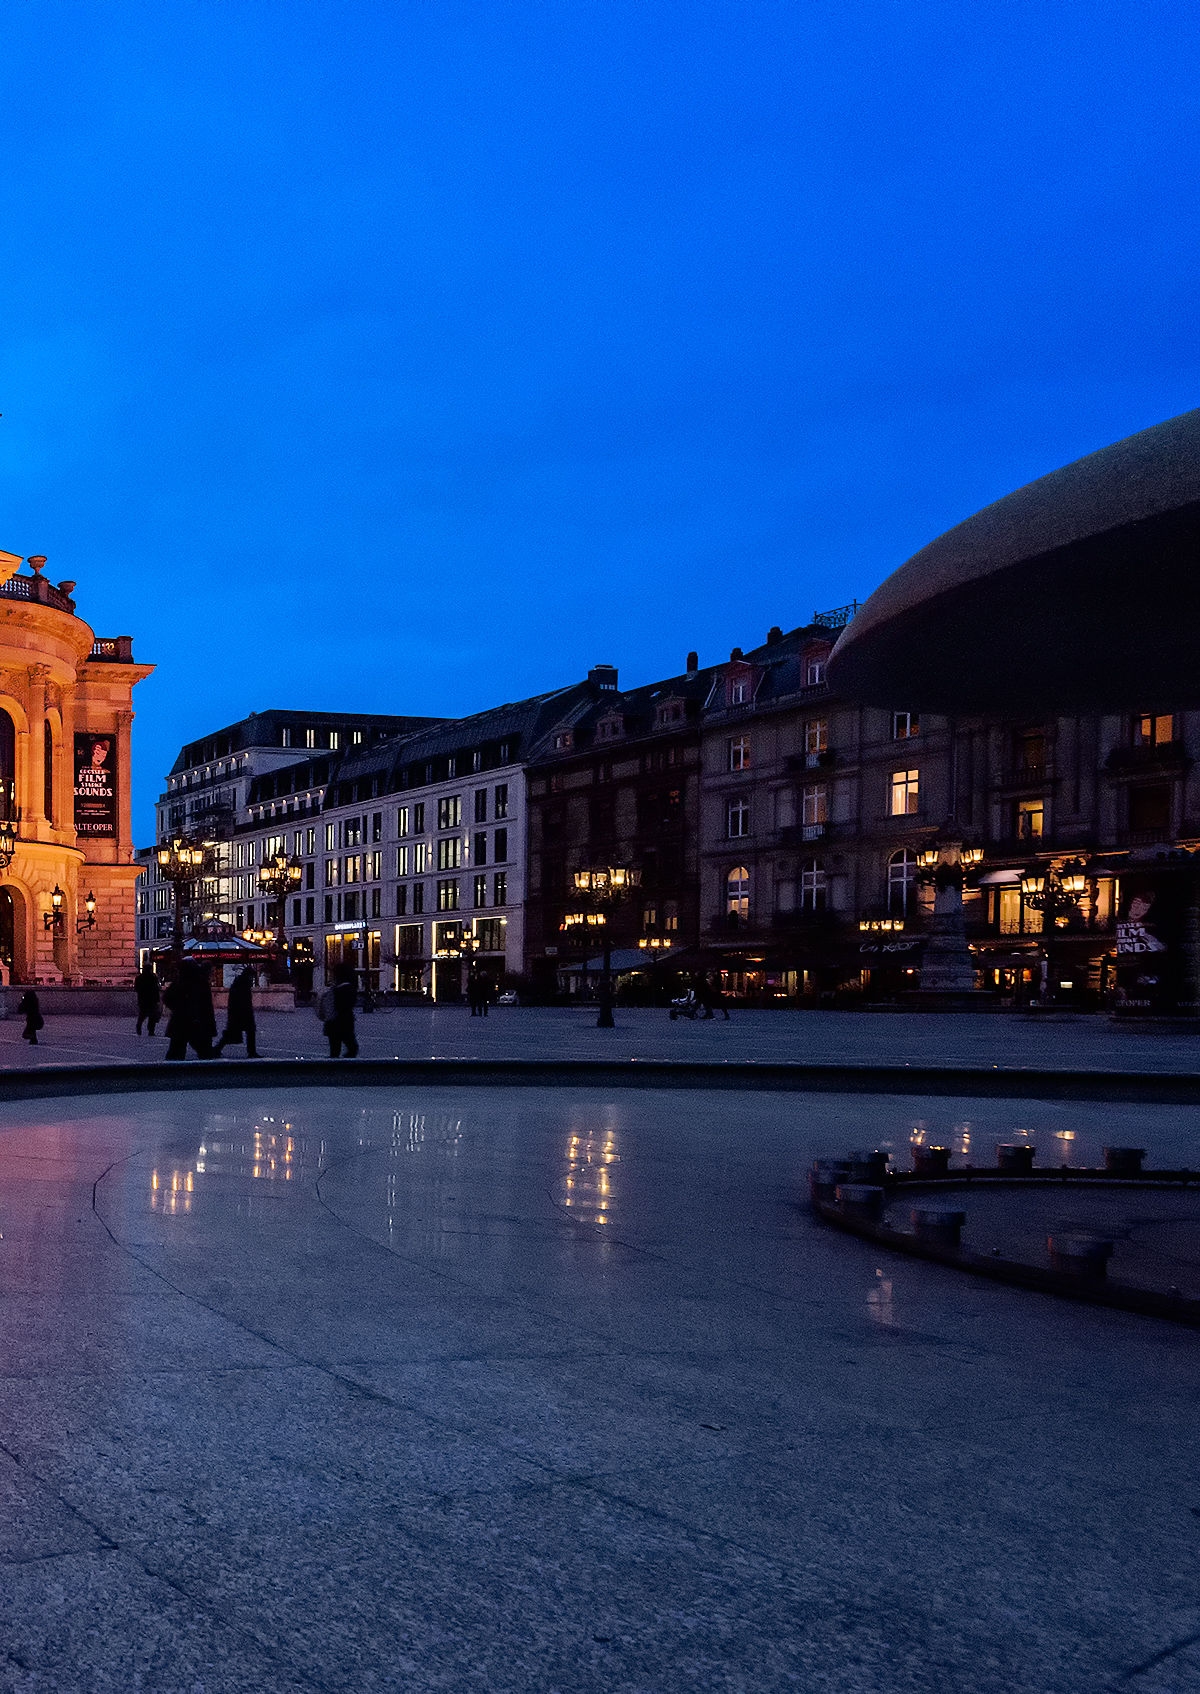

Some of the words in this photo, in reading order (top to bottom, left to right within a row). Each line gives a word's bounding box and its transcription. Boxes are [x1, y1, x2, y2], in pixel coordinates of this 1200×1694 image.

[78, 774, 107, 783] FILM
[73, 787, 113, 796] SOUNDS
[92, 823, 113, 831] OPER
